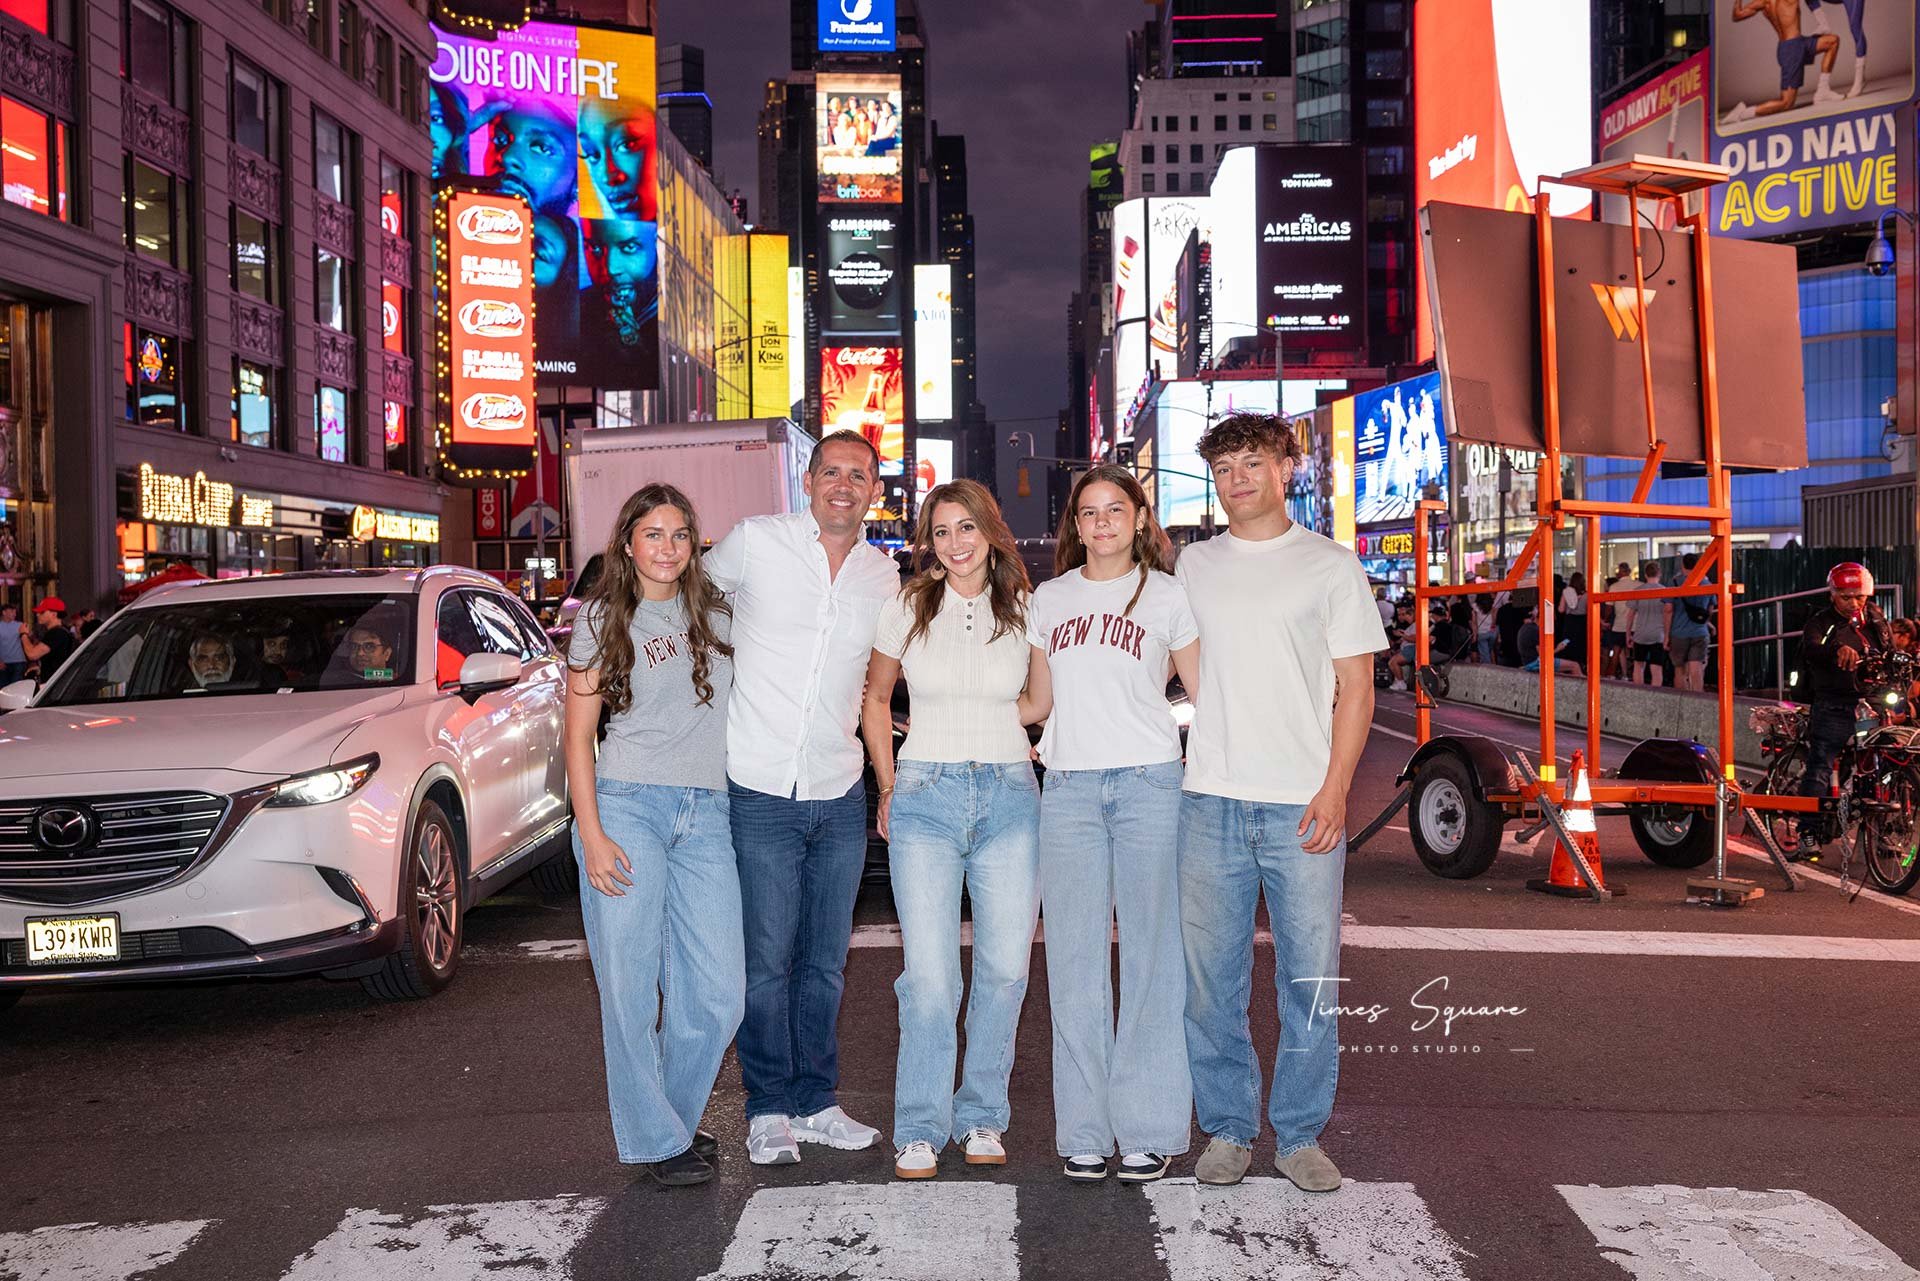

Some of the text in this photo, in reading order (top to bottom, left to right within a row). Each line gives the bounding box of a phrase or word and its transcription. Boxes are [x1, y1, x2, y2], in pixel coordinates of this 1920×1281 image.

[543, 36, 581, 50] SERIES
[509, 51, 550, 93] ON
[557, 56, 619, 101] FIRE
[1604, 63, 1702, 139] OLD NAVY ACTIVE
[1721, 134, 1793, 177] OLD
[837, 184, 882, 198] britbox
[1281, 178, 1333, 188] TOM HANKS
[1719, 153, 1896, 232] ACTIVE
[830, 219, 890, 231] SAMSUNG
[1153, 210, 1201, 241] ARKAY
[1263, 221, 1351, 235] AMERICAS
[763, 325, 778, 334] THE
[760, 336, 781, 348] LION
[758, 350, 784, 363] KING
[1469, 443, 1499, 477] OLD
[140, 462, 194, 524] BUBBA
[1366, 535, 1381, 555] NY
[1382, 533, 1413, 555] GIFTS
[1048, 612, 1147, 661] NEW YORK
[642, 635, 679, 669] NEW
[1584, 837, 1595, 846] PA
[32, 926, 112, 952] L39 KWR
[32, 955, 115, 967] OPEN ROAD MAZDA
